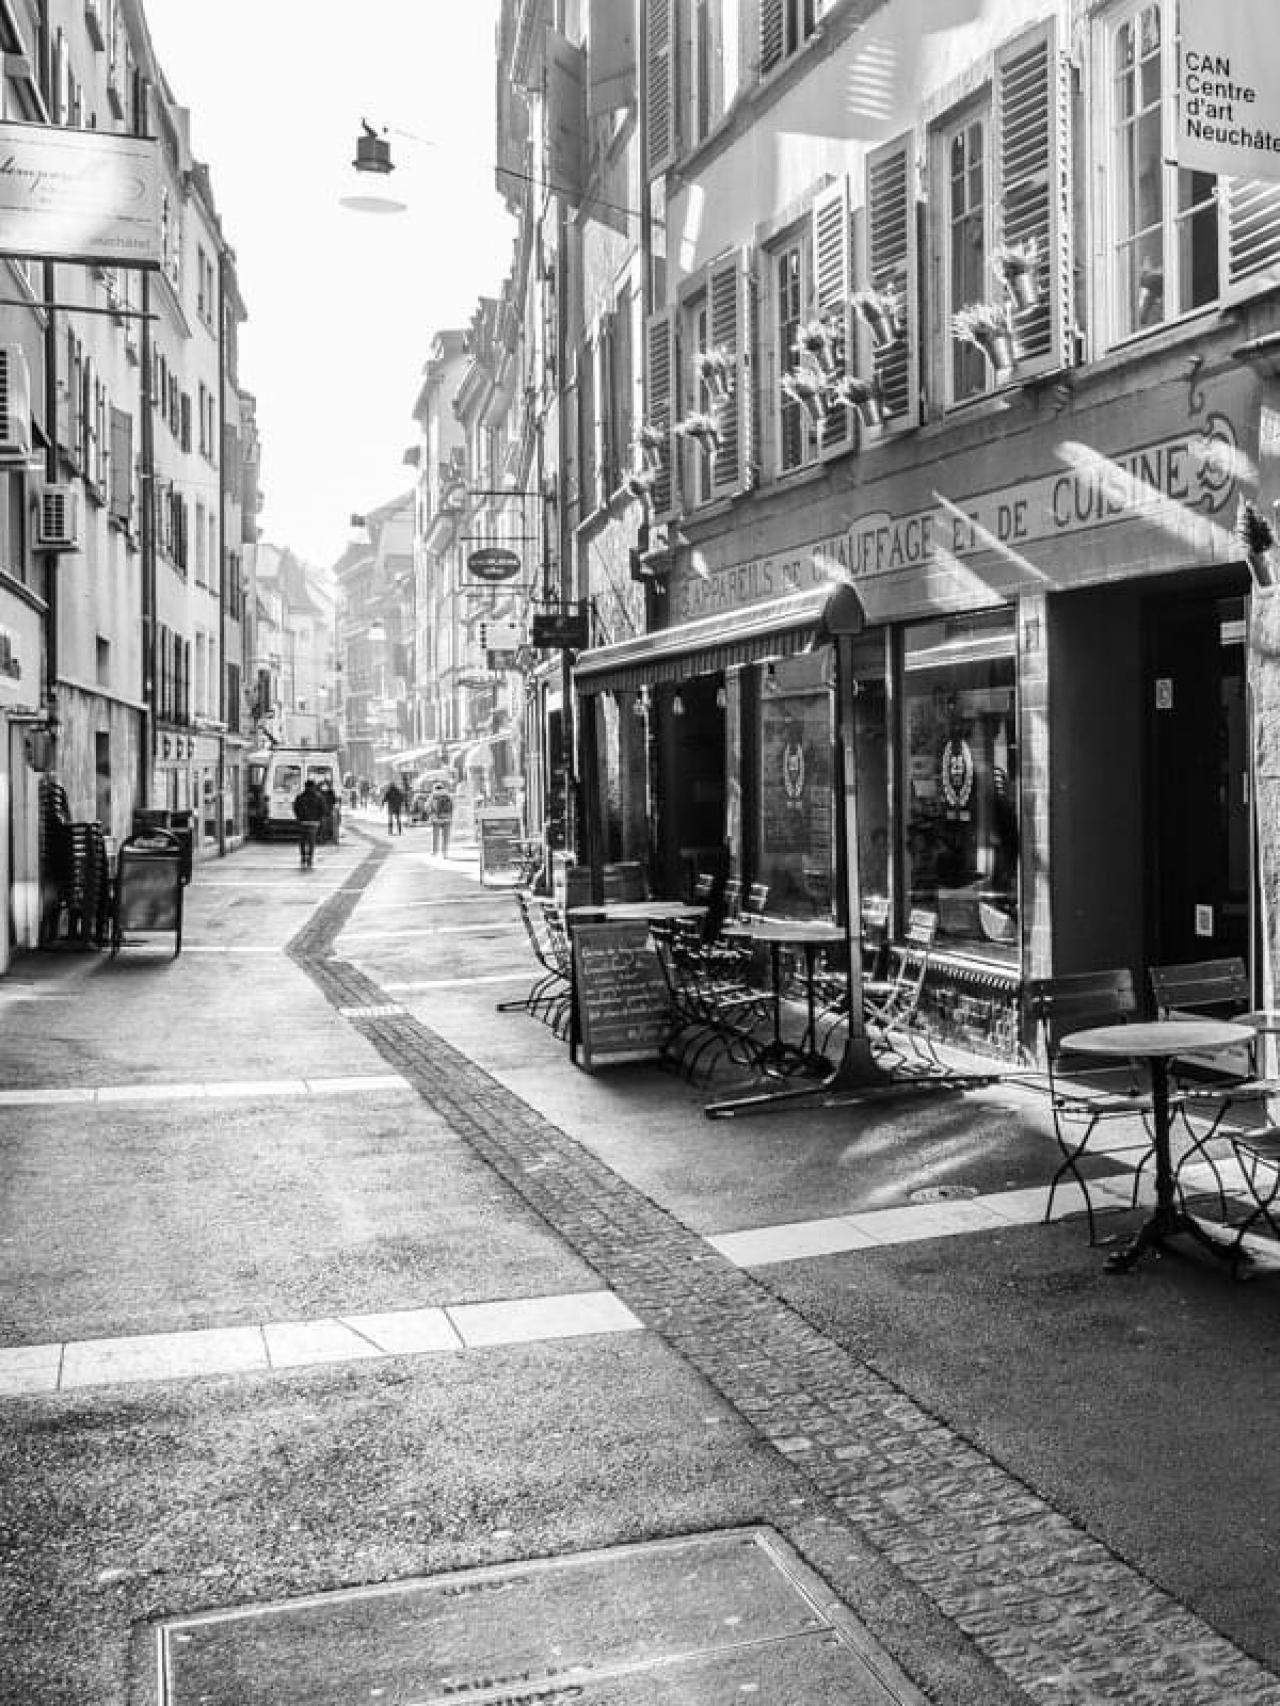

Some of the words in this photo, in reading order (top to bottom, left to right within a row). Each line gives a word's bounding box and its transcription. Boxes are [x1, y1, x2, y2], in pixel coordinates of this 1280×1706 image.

[1185, 51, 1230, 77] CAN
[1185, 74, 1256, 103] Centre
[1186, 97, 1233, 122] d'art
[812, 515, 935, 583] CHAUFFAGE
[953, 510, 979, 551] ET
[998, 500, 1028, 540] DE
[1054, 444, 1189, 528] CUISINE
